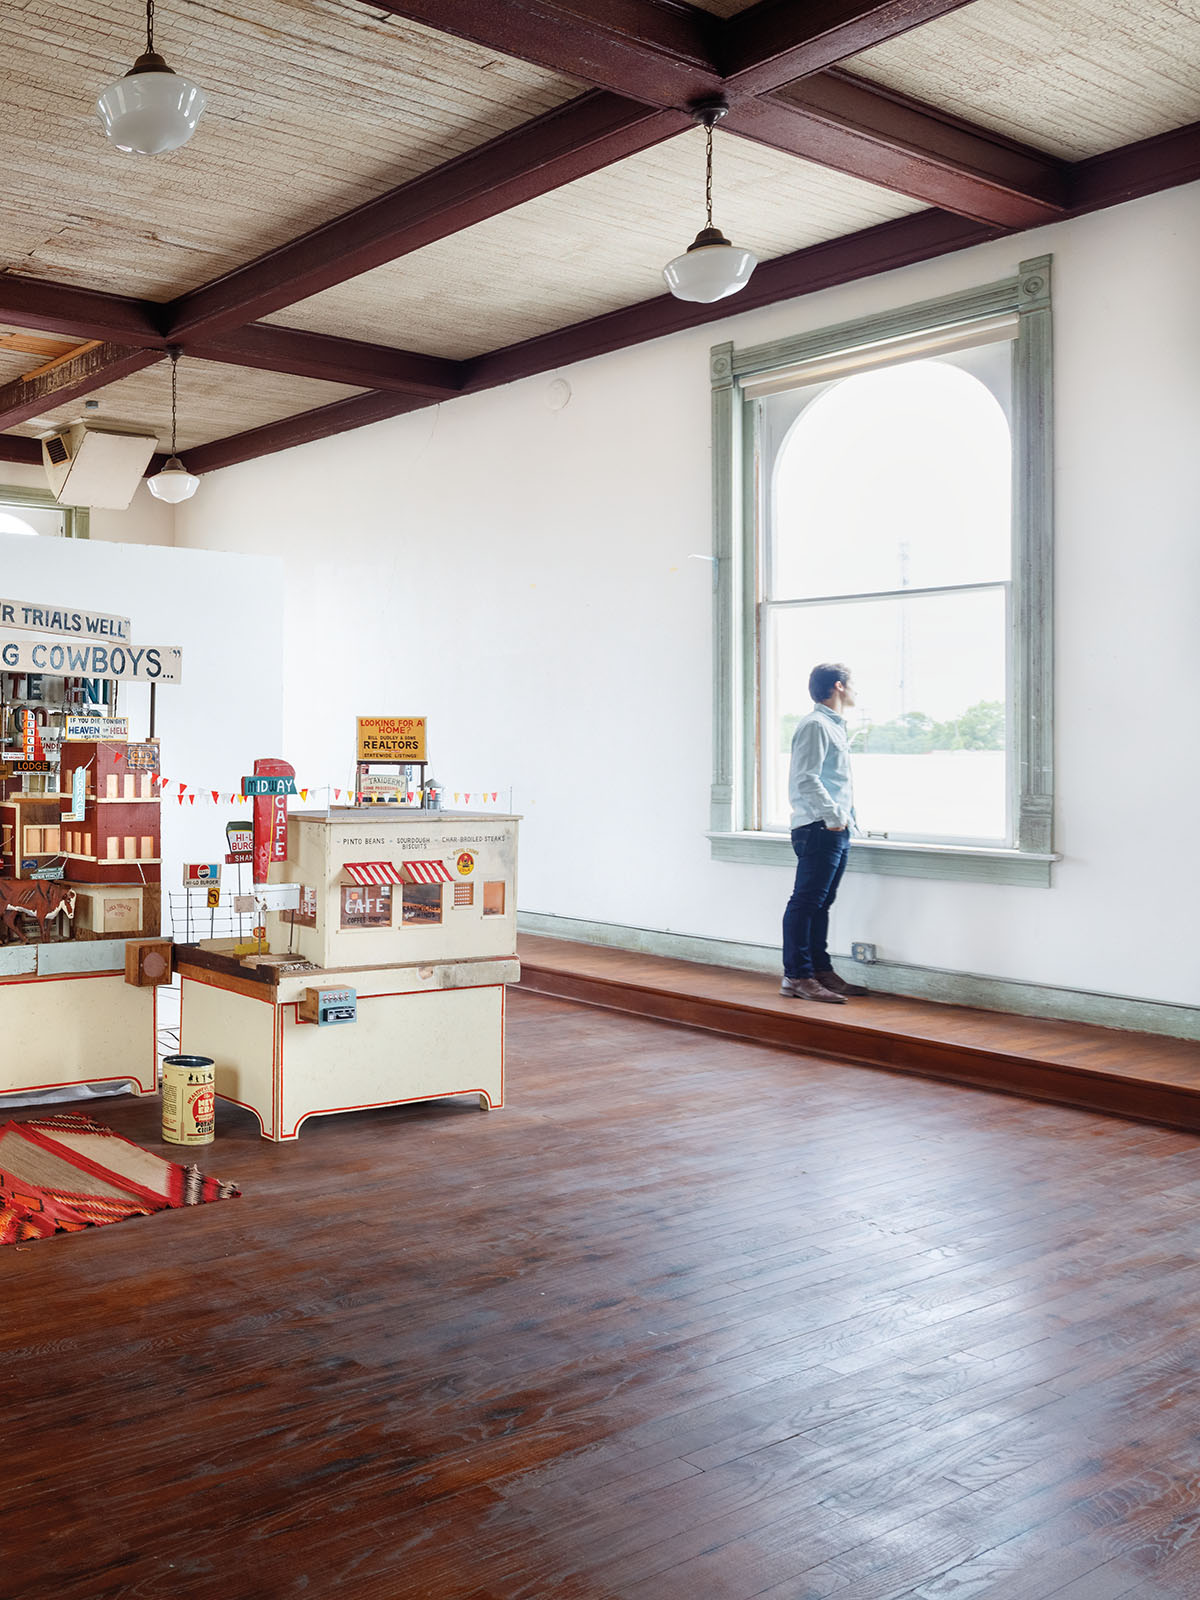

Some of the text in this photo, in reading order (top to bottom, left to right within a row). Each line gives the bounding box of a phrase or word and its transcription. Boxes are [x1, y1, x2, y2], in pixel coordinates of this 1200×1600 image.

[22, 608, 81, 632] TRIALS
[364, 741, 418, 749] REALTORS
[18, 762, 48, 770] LODGE
[248, 780, 292, 793] MIDWAY
[370, 777, 404, 786] TAXIDERMY
[275, 796, 285, 855] CAFE
[232, 842, 253, 850] BURG
[345, 898, 384, 914] CAFE
